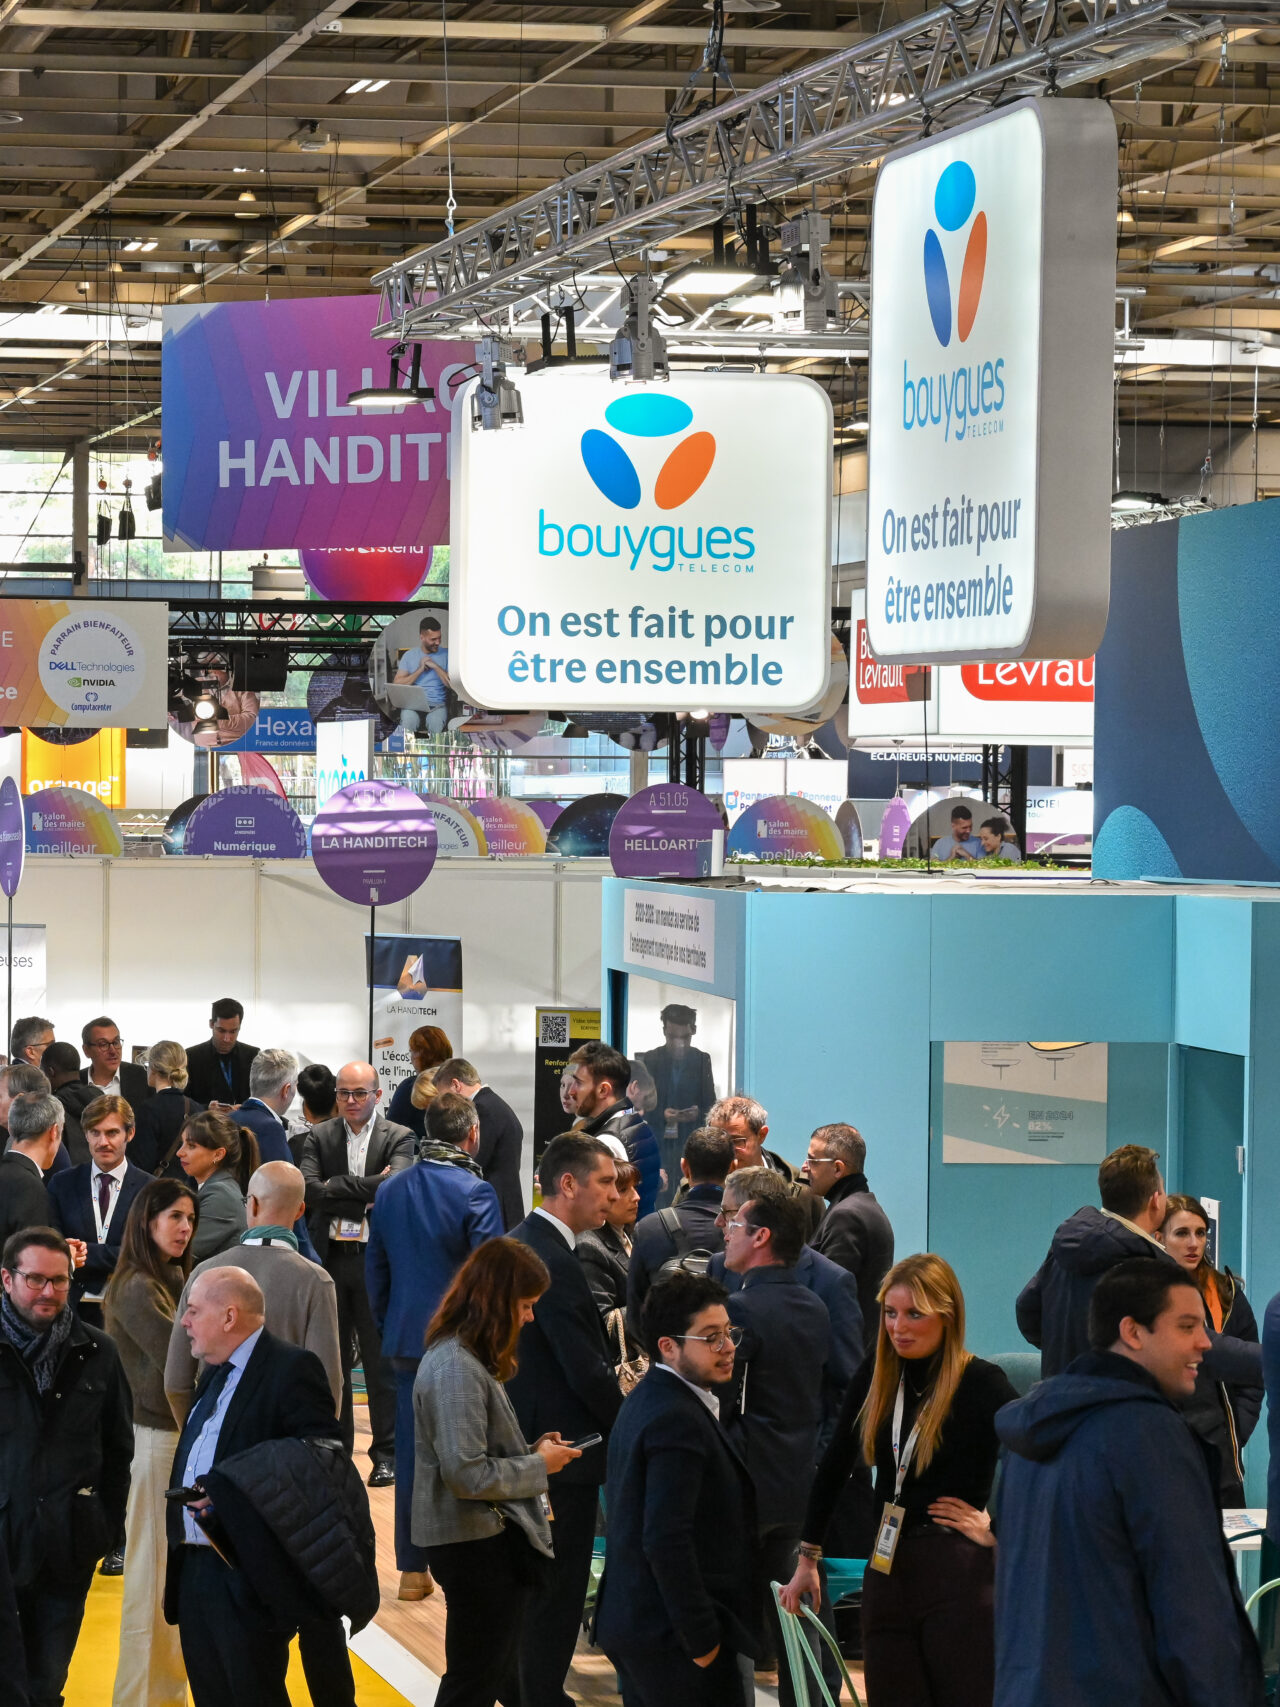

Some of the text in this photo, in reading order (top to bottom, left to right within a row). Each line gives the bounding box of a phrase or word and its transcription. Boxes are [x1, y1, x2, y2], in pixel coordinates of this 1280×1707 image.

[264, 362, 477, 419] VILLAG
[903, 357, 1005, 443] bouygues
[967, 419, 1004, 438] TELECOM
[218, 432, 451, 488] HANDIT
[882, 494, 1021, 556] On est fait pour
[538, 508, 756, 572] bouygues
[678, 563, 754, 573] TELECOM
[884, 563, 1013, 624] être ensemble
[497, 605, 795, 647] On est fait pour
[50, 620, 135, 657] PARRAIN BIENFAITEUR
[77, 662, 135, 674] Technologies
[507, 650, 783, 686] être ensemble
[977, 661, 1096, 687] Levrau
[71, 702, 112, 713] Computacenter
[255, 716, 316, 737] Hexa
[649, 791, 689, 807] A 51.05
[43, 812, 66, 820] salon
[44, 820, 86, 828] des maires
[768, 820, 789, 828] salon
[768, 827, 808, 836] des maires
[36, 841, 97, 854] meilleur
[213, 841, 277, 853] Numérique
[321, 836, 428, 849] LA HANDITECH
[487, 839, 528, 850] eilleur
[624, 839, 712, 851] HELLOART
[386, 1005, 437, 1016] LA HANDITECH
